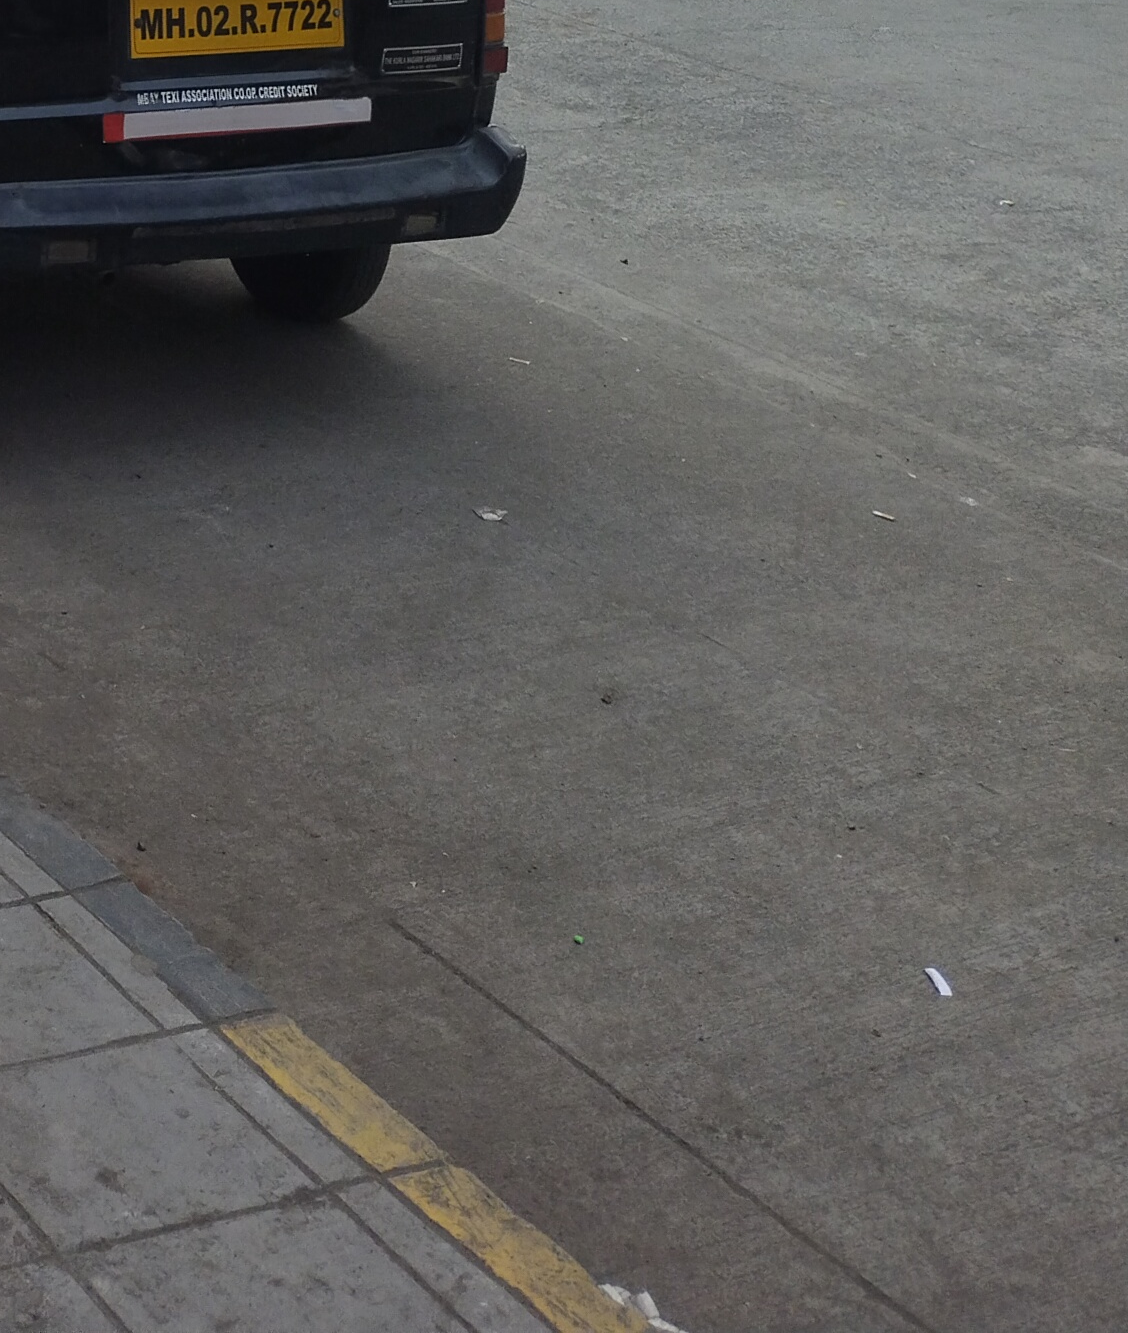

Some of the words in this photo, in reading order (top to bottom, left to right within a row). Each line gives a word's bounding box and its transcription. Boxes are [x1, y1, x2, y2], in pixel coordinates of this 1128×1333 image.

[160, 90, 180, 104] TEXI
[181, 88, 233, 103] ASSOCIATION
[258, 85, 285, 99] CREDIT
[286, 84, 318, 98] SOCIETY
